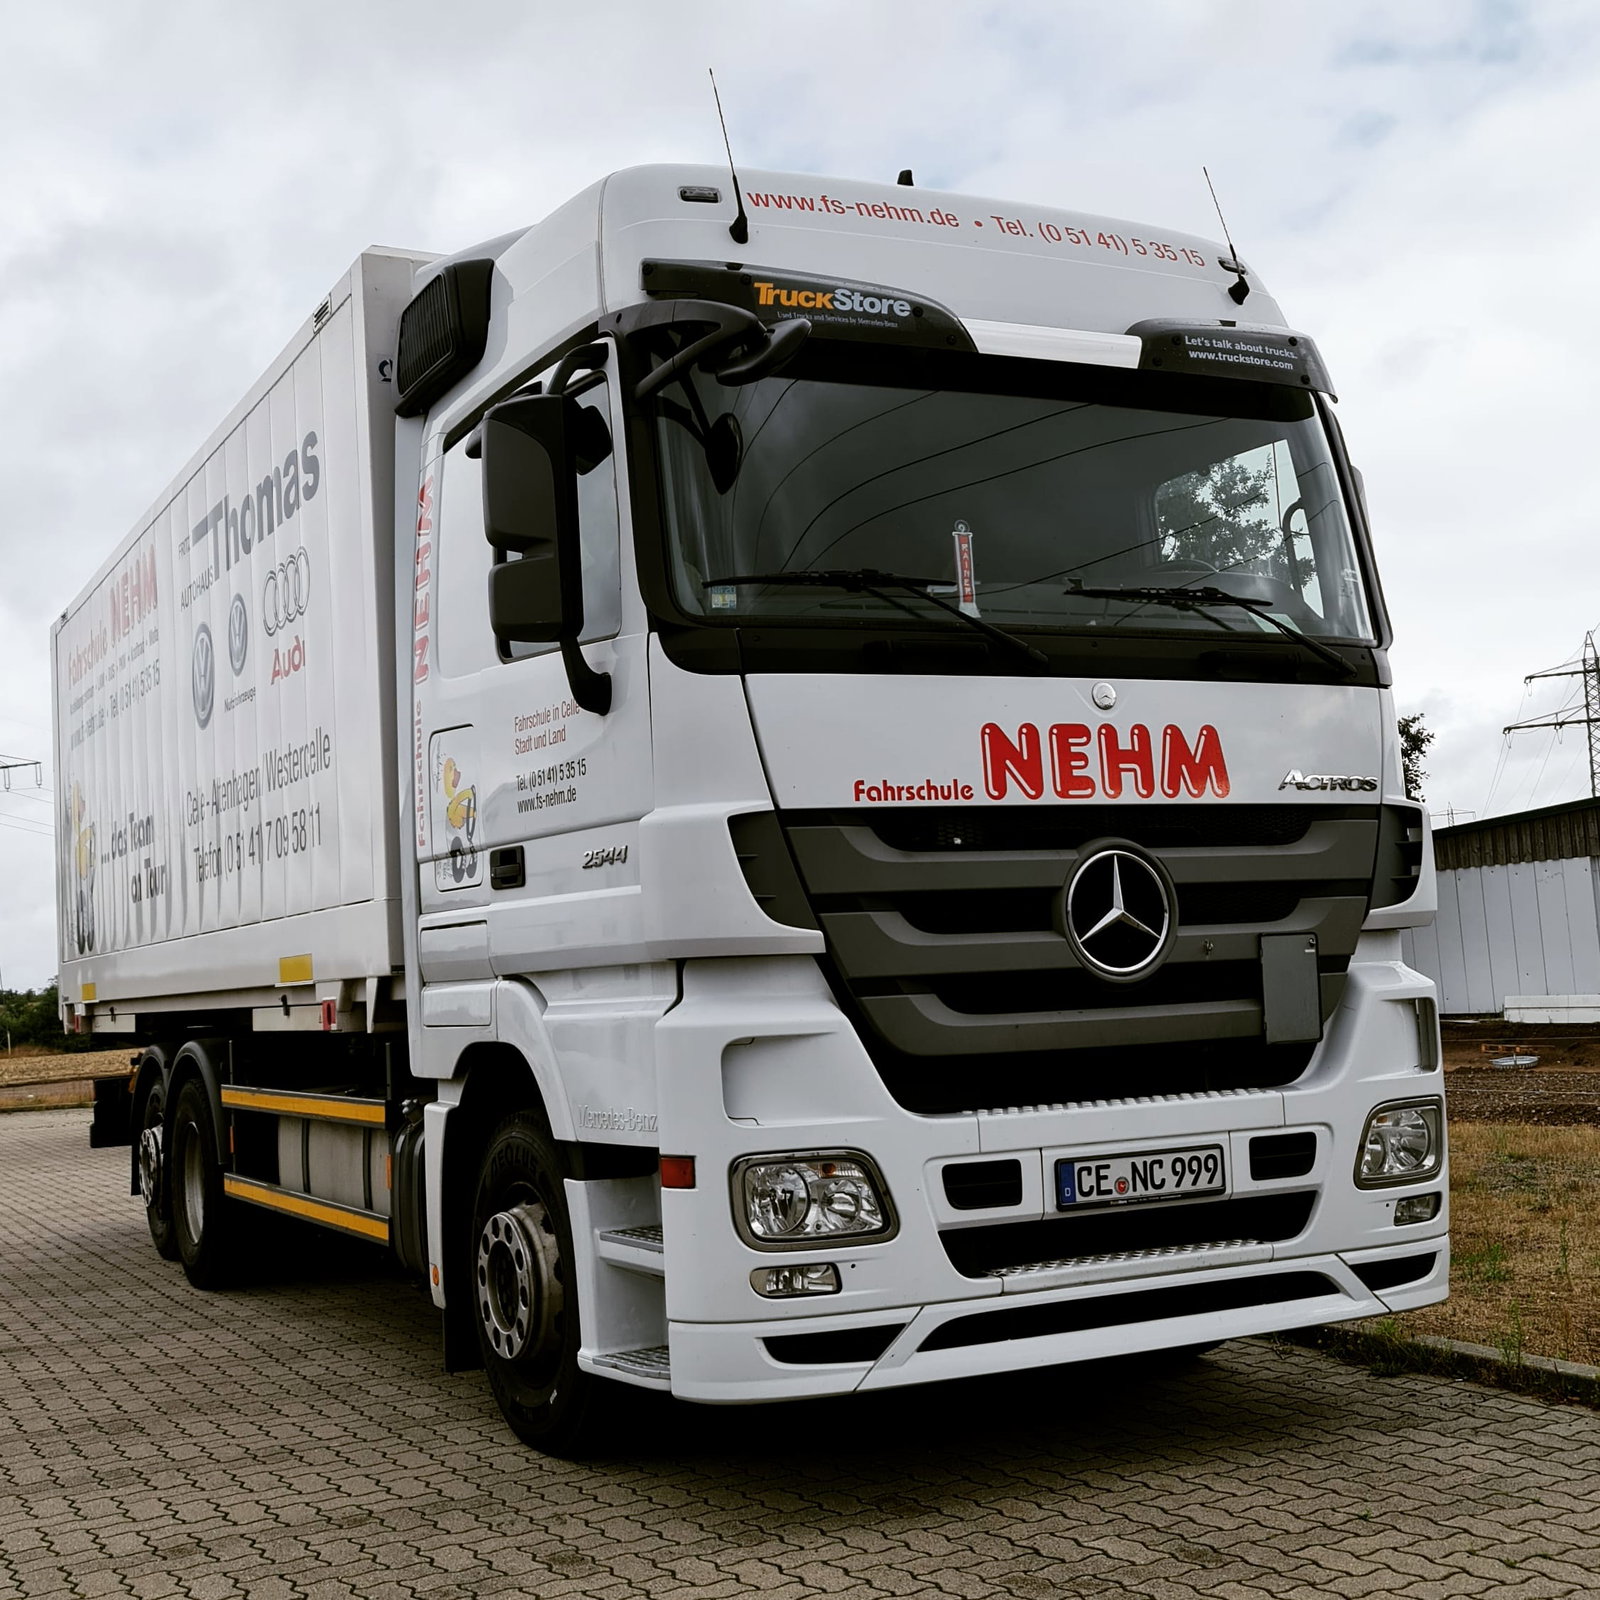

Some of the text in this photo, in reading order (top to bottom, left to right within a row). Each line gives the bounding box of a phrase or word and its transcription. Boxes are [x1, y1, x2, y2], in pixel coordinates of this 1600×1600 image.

[747, 191, 1206, 267] www.fs-nehm.de Tel. (0 51 41) 5 35 15
[754, 282, 912, 317] TruckStore
[777, 311, 791, 319] Used
[825, 315, 849, 323] Services
[849, 317, 857, 326] by
[857, 317, 898, 328] Mercedes-Benz
[1184, 335, 1299, 359] Let's talk about trucks.
[1188, 349, 1294, 371] www.truckstore.com
[192, 431, 320, 582] Thomas
[181, 565, 214, 612] AUTOHAUS
[415, 474, 434, 685] NEHM
[961, 543, 972, 596] RAINER
[110, 543, 159, 648] NEHM
[270, 635, 306, 685] Audi
[514, 703, 551, 733] Fahrschule
[553, 703, 560, 720] in
[515, 725, 566, 755] Stadt und Land
[980, 721, 1231, 800] NEHM
[415, 698, 426, 847] Fahrschule
[516, 758, 587, 792] Tel. (0 51 41) 5 35 15
[853, 779, 974, 802] Fahrschule
[517, 785, 577, 814] www.fs-nehm.de
[129, 812, 155, 852] Team
[194, 841, 223, 884] Telefon
[236, 831, 245, 871] 51
[265, 821, 272, 861] 7
[276, 814, 289, 859] 09
[292, 808, 307, 854] 58
[309, 801, 321, 847] 11
[144, 857, 167, 899] Tour
[582, 845, 629, 870] 2544
[578, 1104, 659, 1133] Mercedes-Benz
[1064, 1153, 1219, 1198] D CE NC 999
